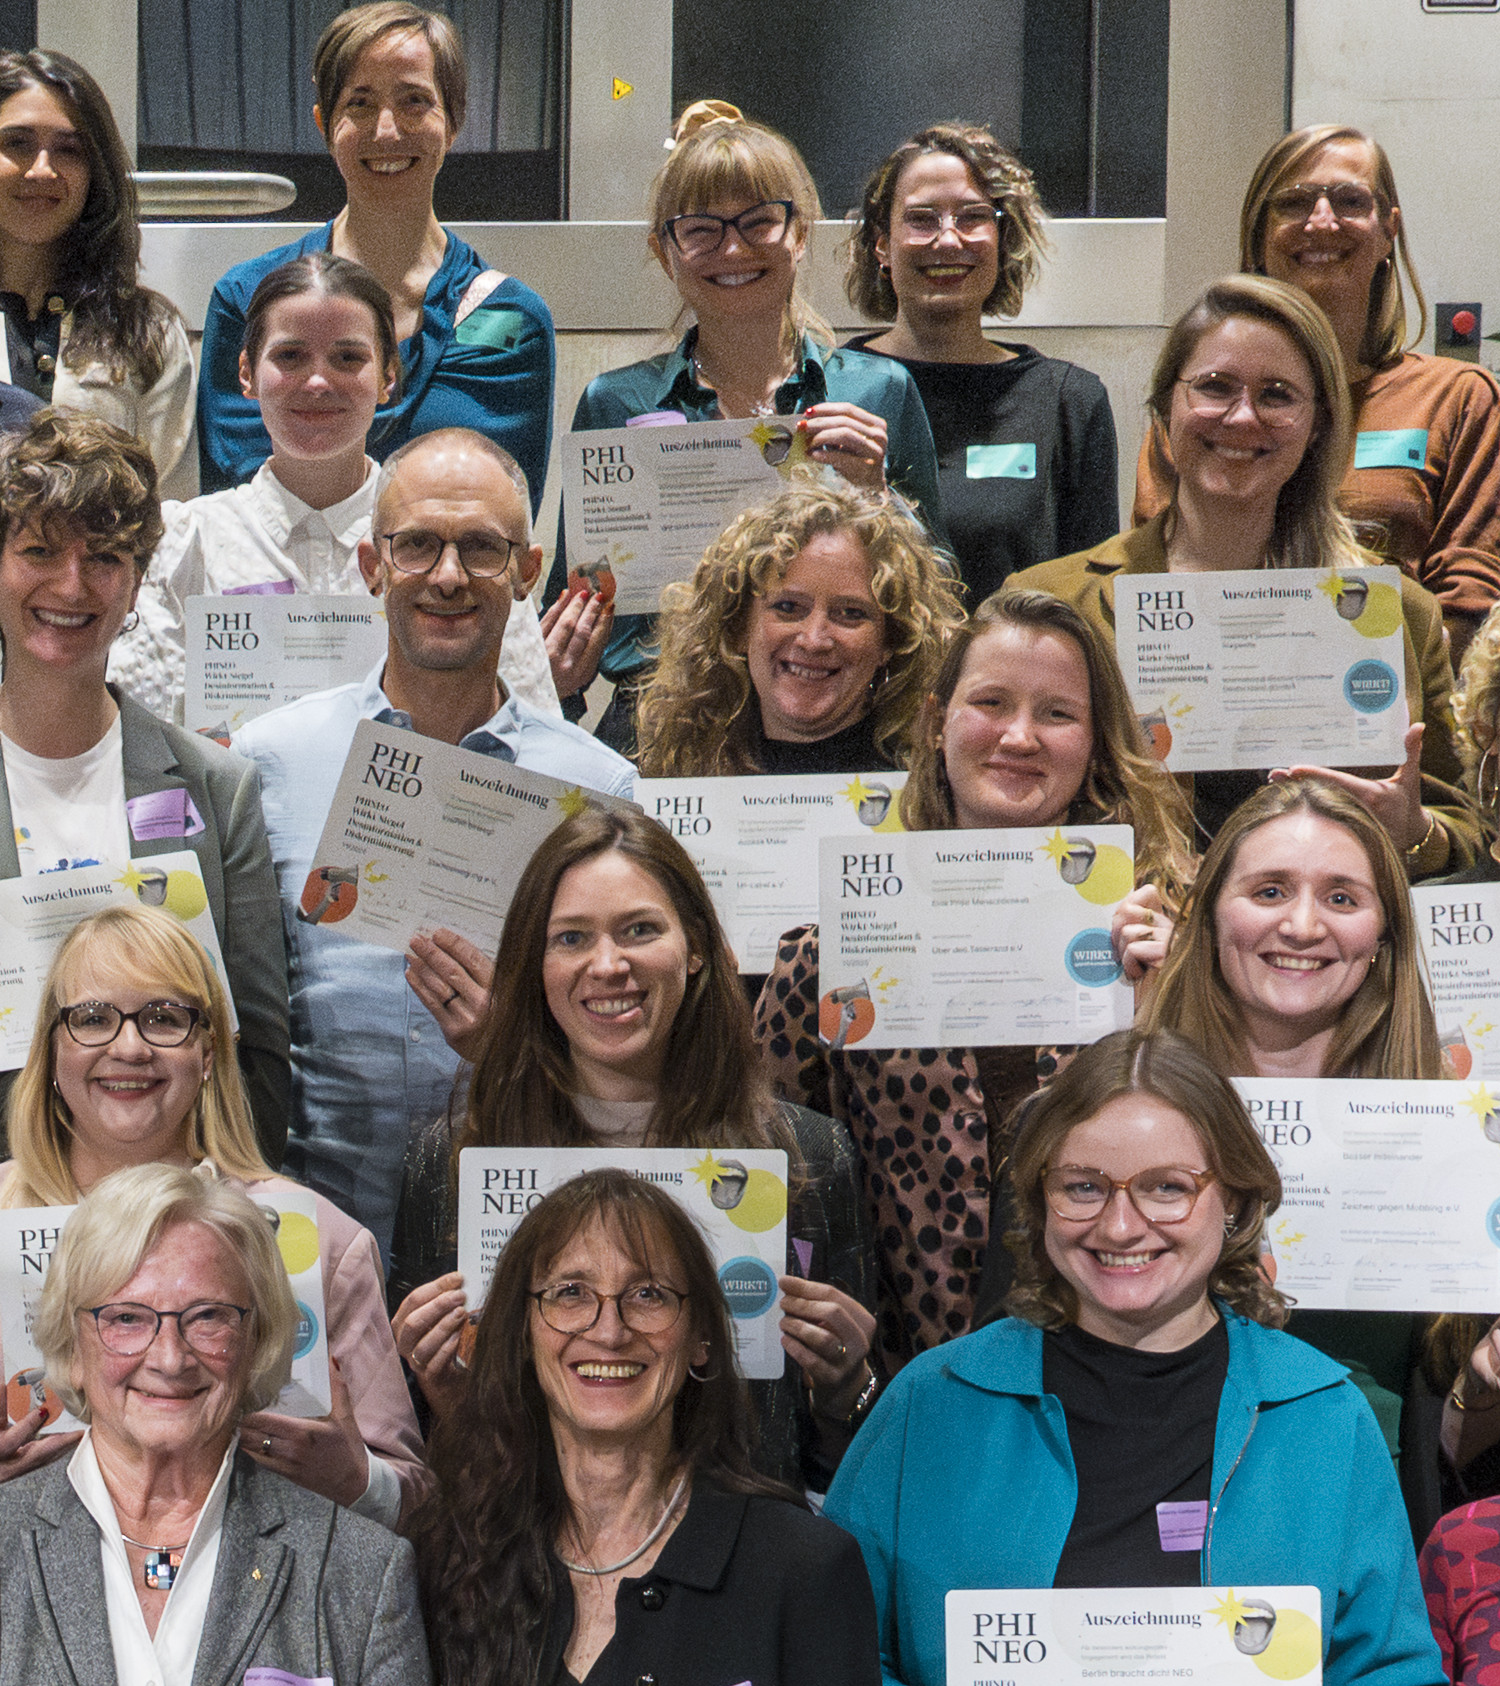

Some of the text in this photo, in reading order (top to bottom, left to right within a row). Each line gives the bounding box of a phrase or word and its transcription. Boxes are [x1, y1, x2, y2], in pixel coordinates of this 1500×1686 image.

[581, 445, 625, 465] PHI
[582, 465, 633, 485] NEO
[1136, 591, 1184, 610] PHI
[206, 613, 251, 630] PHI
[1137, 611, 1193, 631] NEO
[206, 632, 258, 650] NEO
[369, 742, 422, 775] PHI
[363, 764, 422, 797] NEO
[654, 796, 703, 815] PHI
[841, 853, 893, 874] PHI
[841, 876, 902, 897] NEO
[1429, 902, 1482, 924] PHI
[1430, 924, 1493, 946] NEO
[482, 1168, 537, 1189] PHI
[974, 1613, 1035, 1636] PHI
[1083, 1611, 1201, 1626] Auszeichnung
[974, 1640, 1046, 1663] NEO
